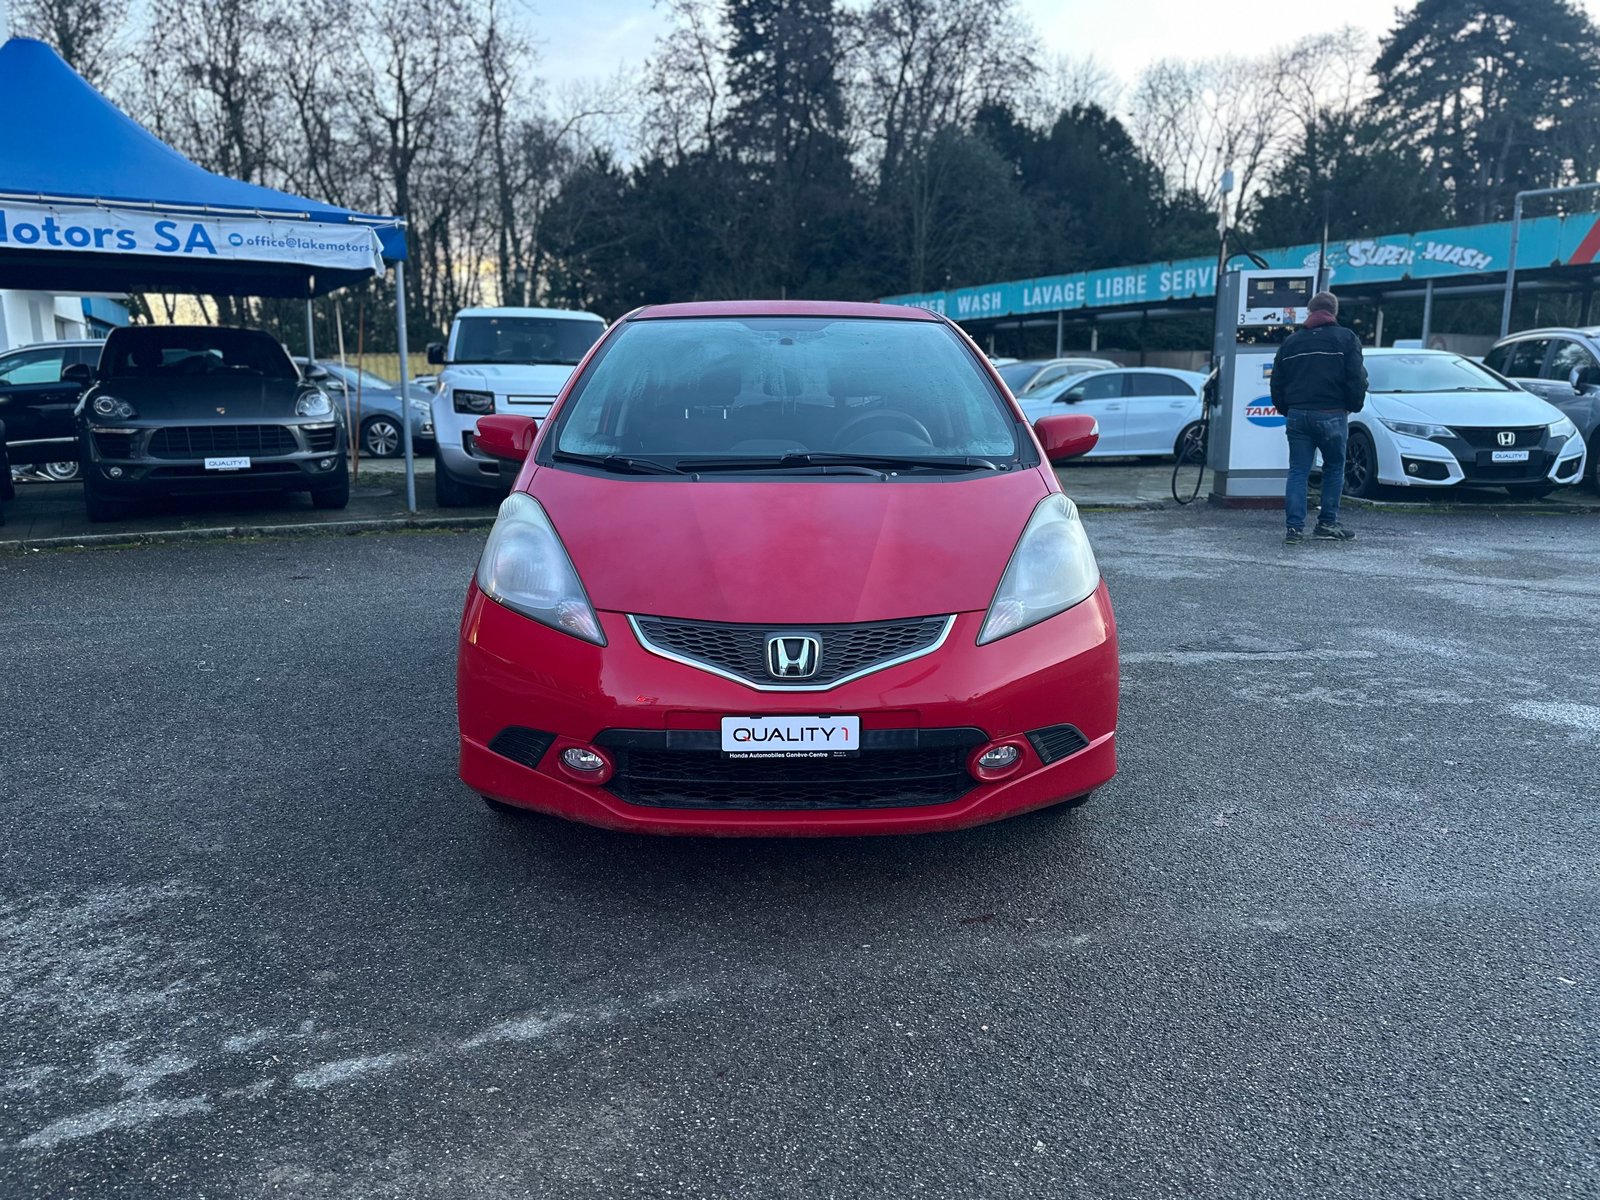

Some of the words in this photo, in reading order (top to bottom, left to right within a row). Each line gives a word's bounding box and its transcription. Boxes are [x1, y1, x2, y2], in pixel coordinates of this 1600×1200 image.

[154, 220, 218, 255] SA
[1348, 241, 1415, 267] SUPER
[1423, 242, 1492, 269] WASH
[958, 291, 1001, 313] WASH
[1023, 281, 1086, 306] LAVAGE
[1096, 275, 1147, 298] LIBRE
[1160, 264, 1244, 292] SERVI
[1240, 313, 1246, 324] 3
[1245, 407, 1283, 416] TAM
[733, 727, 836, 742] QUALITY
[841, 727, 849, 741] 1
